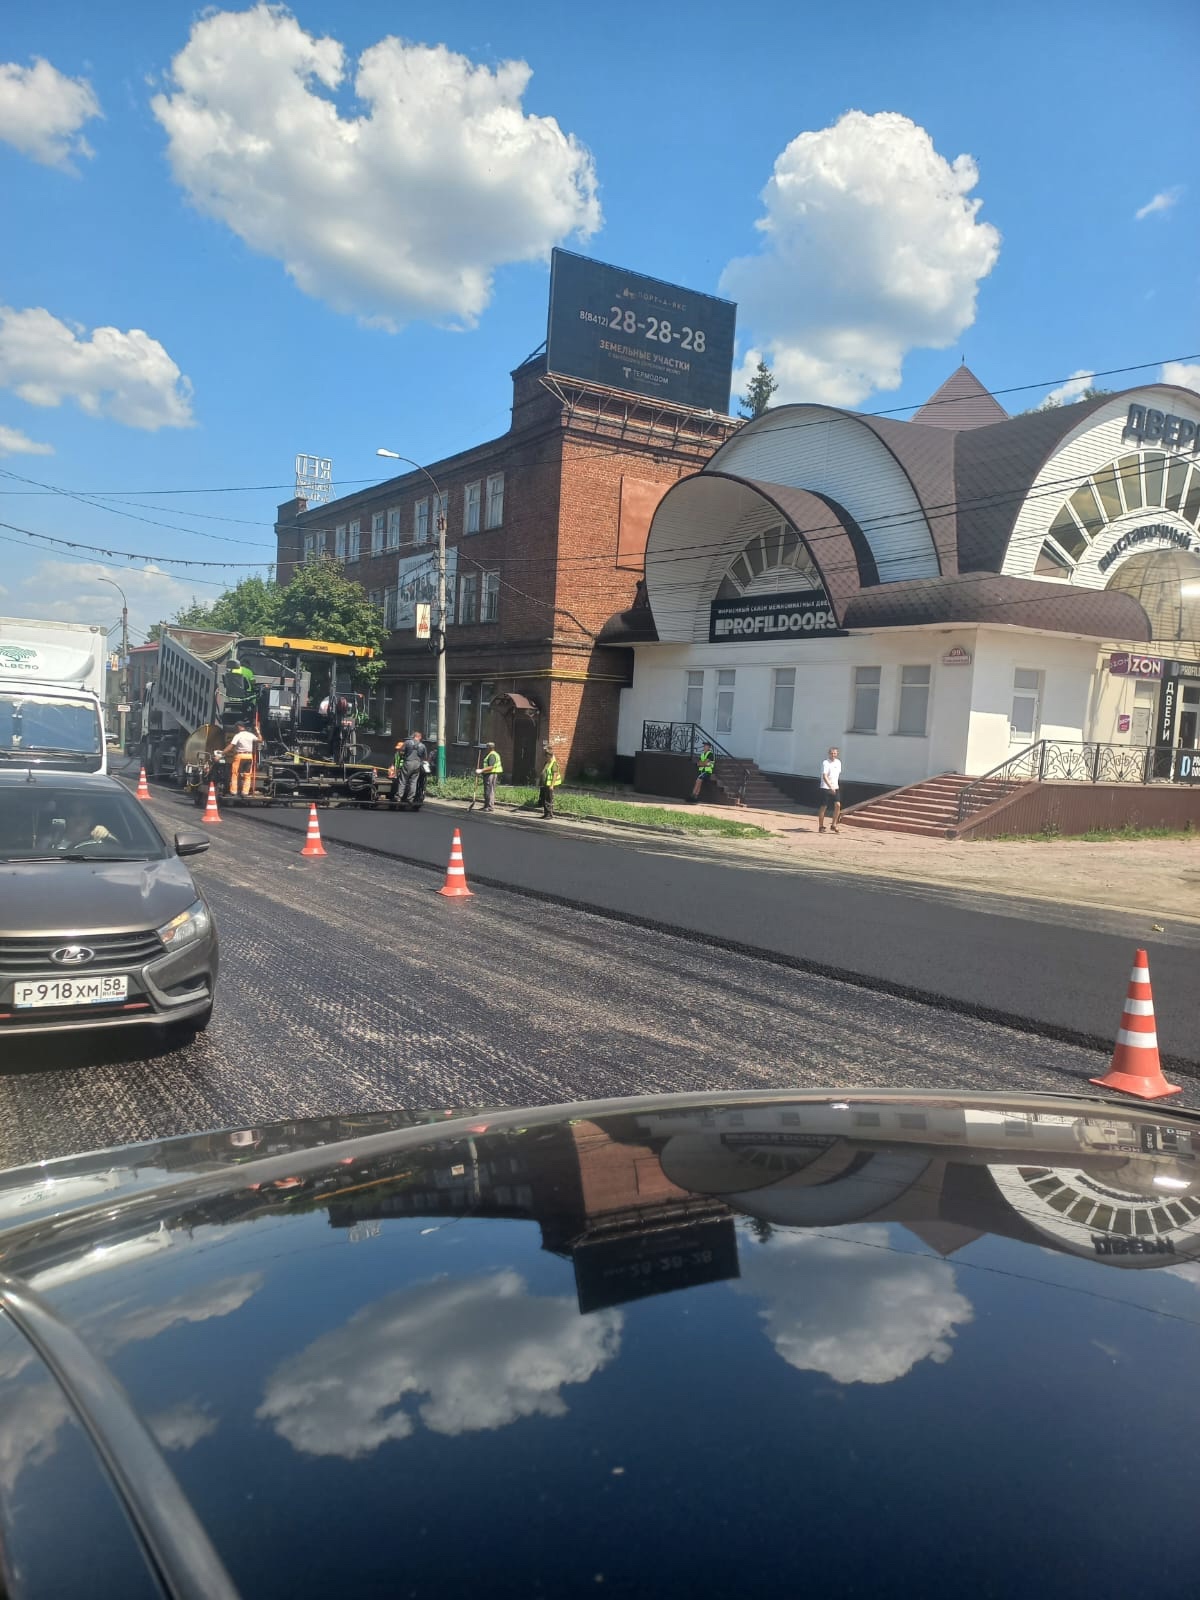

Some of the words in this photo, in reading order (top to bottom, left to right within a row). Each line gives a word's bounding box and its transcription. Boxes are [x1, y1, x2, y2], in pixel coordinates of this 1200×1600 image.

[599, 339, 651, 361] ЗЕМЕЛЬНЫЕ
[653, 353, 690, 371] УЧАСТКИ
[633, 369, 669, 385] ТЕРМОДОМ
[1122, 403, 1200, 454] ДВЕР
[1131, 659, 1161, 674] ZON
[1162, 682, 1174, 741] ДВЕРИ
[103, 978, 121, 991] 58
